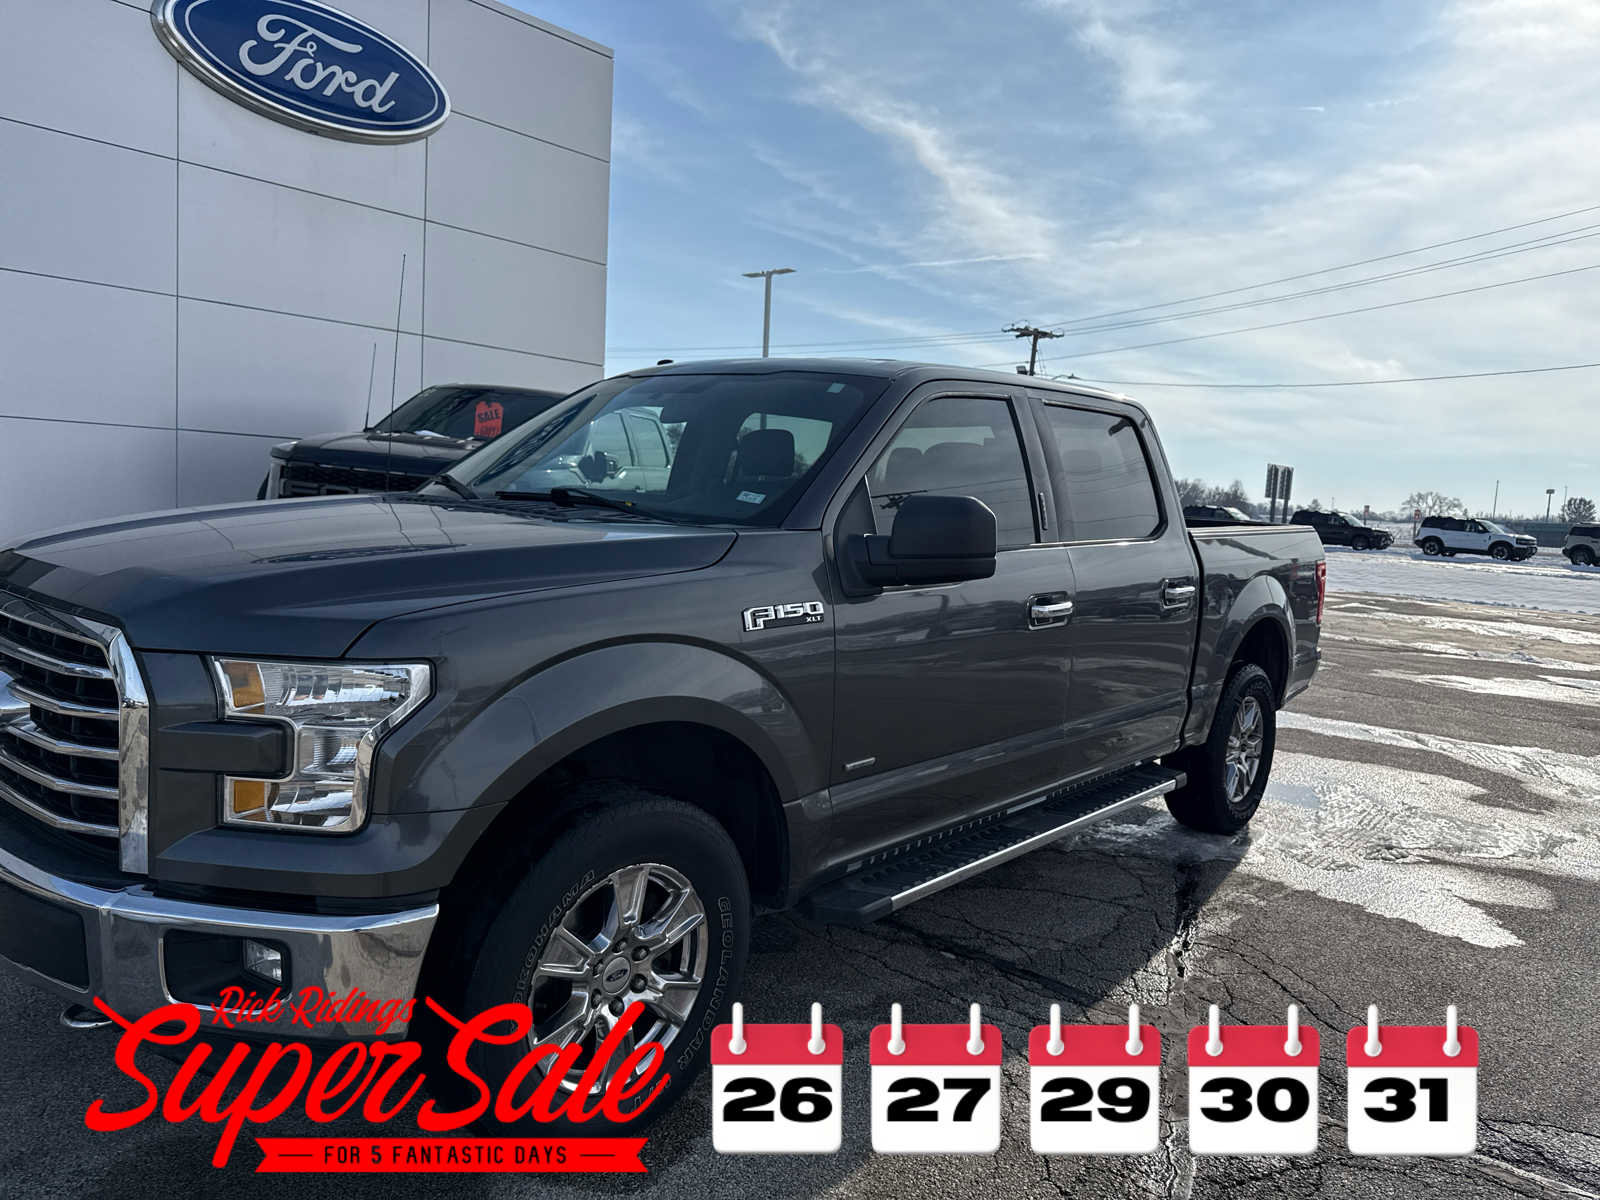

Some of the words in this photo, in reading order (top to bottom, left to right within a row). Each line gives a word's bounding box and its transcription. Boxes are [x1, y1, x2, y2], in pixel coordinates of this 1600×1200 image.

[239, 14, 399, 113] Ford
[806, 615, 822, 623] XLT
[511, 869, 596, 1031] OKOHAMA
[677, 896, 734, 1071] GEOLANDAR
